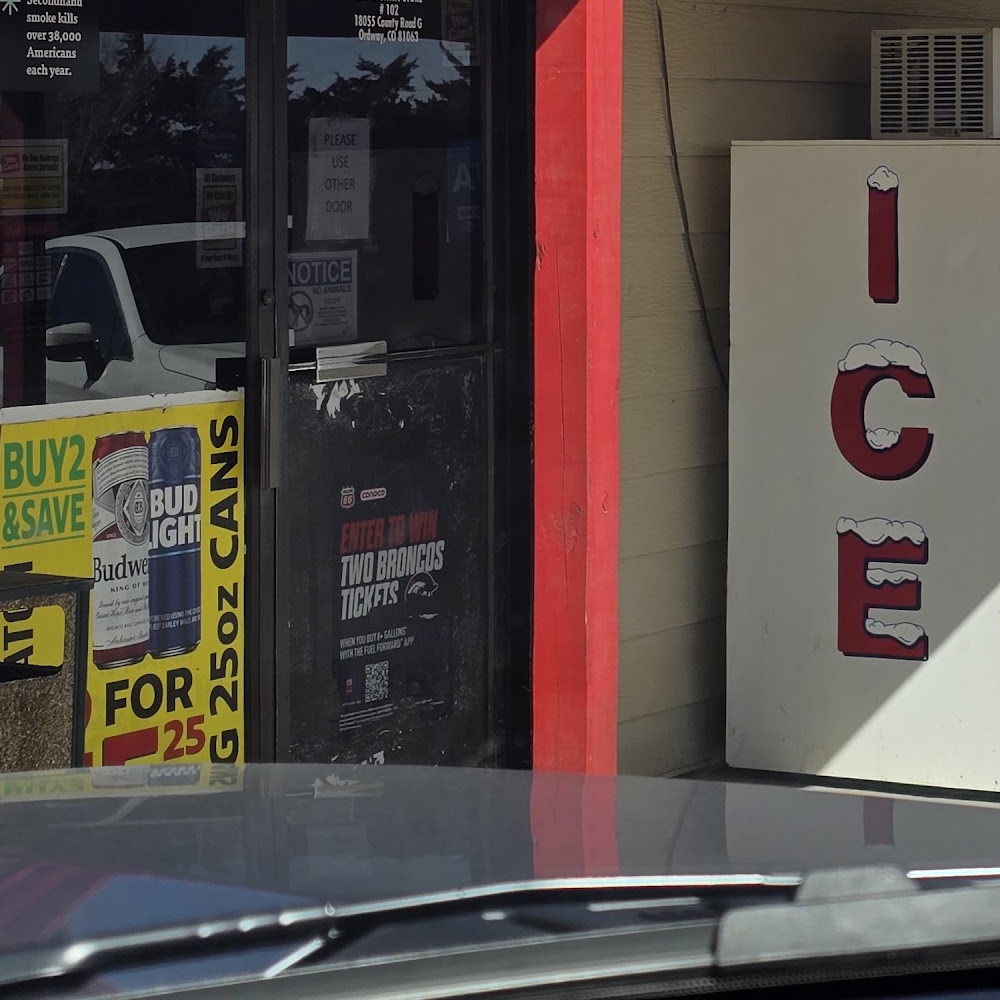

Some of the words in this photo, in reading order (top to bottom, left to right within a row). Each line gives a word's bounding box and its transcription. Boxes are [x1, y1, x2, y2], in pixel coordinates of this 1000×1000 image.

[385, 4, 399, 16] 102
[26, 12, 57, 23] smoke
[58, 12, 79, 24] kills
[354, 14, 376, 27] 18055
[377, 15, 399, 31] County
[400, 16, 416, 29] Road
[417, 17, 423, 29] G
[26, 31, 47, 41] over
[48, 30, 82, 44] 38,000
[387, 29, 397, 42] CO
[398, 31, 419, 43] 81063
[26, 46, 77, 59] Americans
[26, 64, 48, 76] each
[49, 66, 72, 79] year.
[324, 133, 357, 146] PLEASE
[331, 156, 350, 169] USE
[324, 178, 356, 191] OTHER
[325, 200, 353, 213] DOOR
[288, 260, 351, 285] NOTICE
[323, 285, 352, 294] ANIMALS
[830, 165, 935, 661] ICE
[210, 415, 239, 570] CANS
[362, 489, 385, 499] conoco
[150, 484, 198, 519] BUD
[340, 517, 385, 554] ENTER
[388, 514, 406, 548] TO
[409, 510, 438, 543] WIN
[341, 552, 375, 587] TWO
[376, 540, 445, 581] BRONCOS
[110, 585, 129, 593] KING
[340, 637, 355, 648] WHEN
[356, 635, 367, 645] YOU
[367, 632, 377, 643] BUY
[340, 648, 353, 660] WITH
[354, 646, 363, 657] THE
[364, 643, 376, 655] FUEL
[404, 636, 414, 647] APP
[106, 668, 193, 727] FOR
